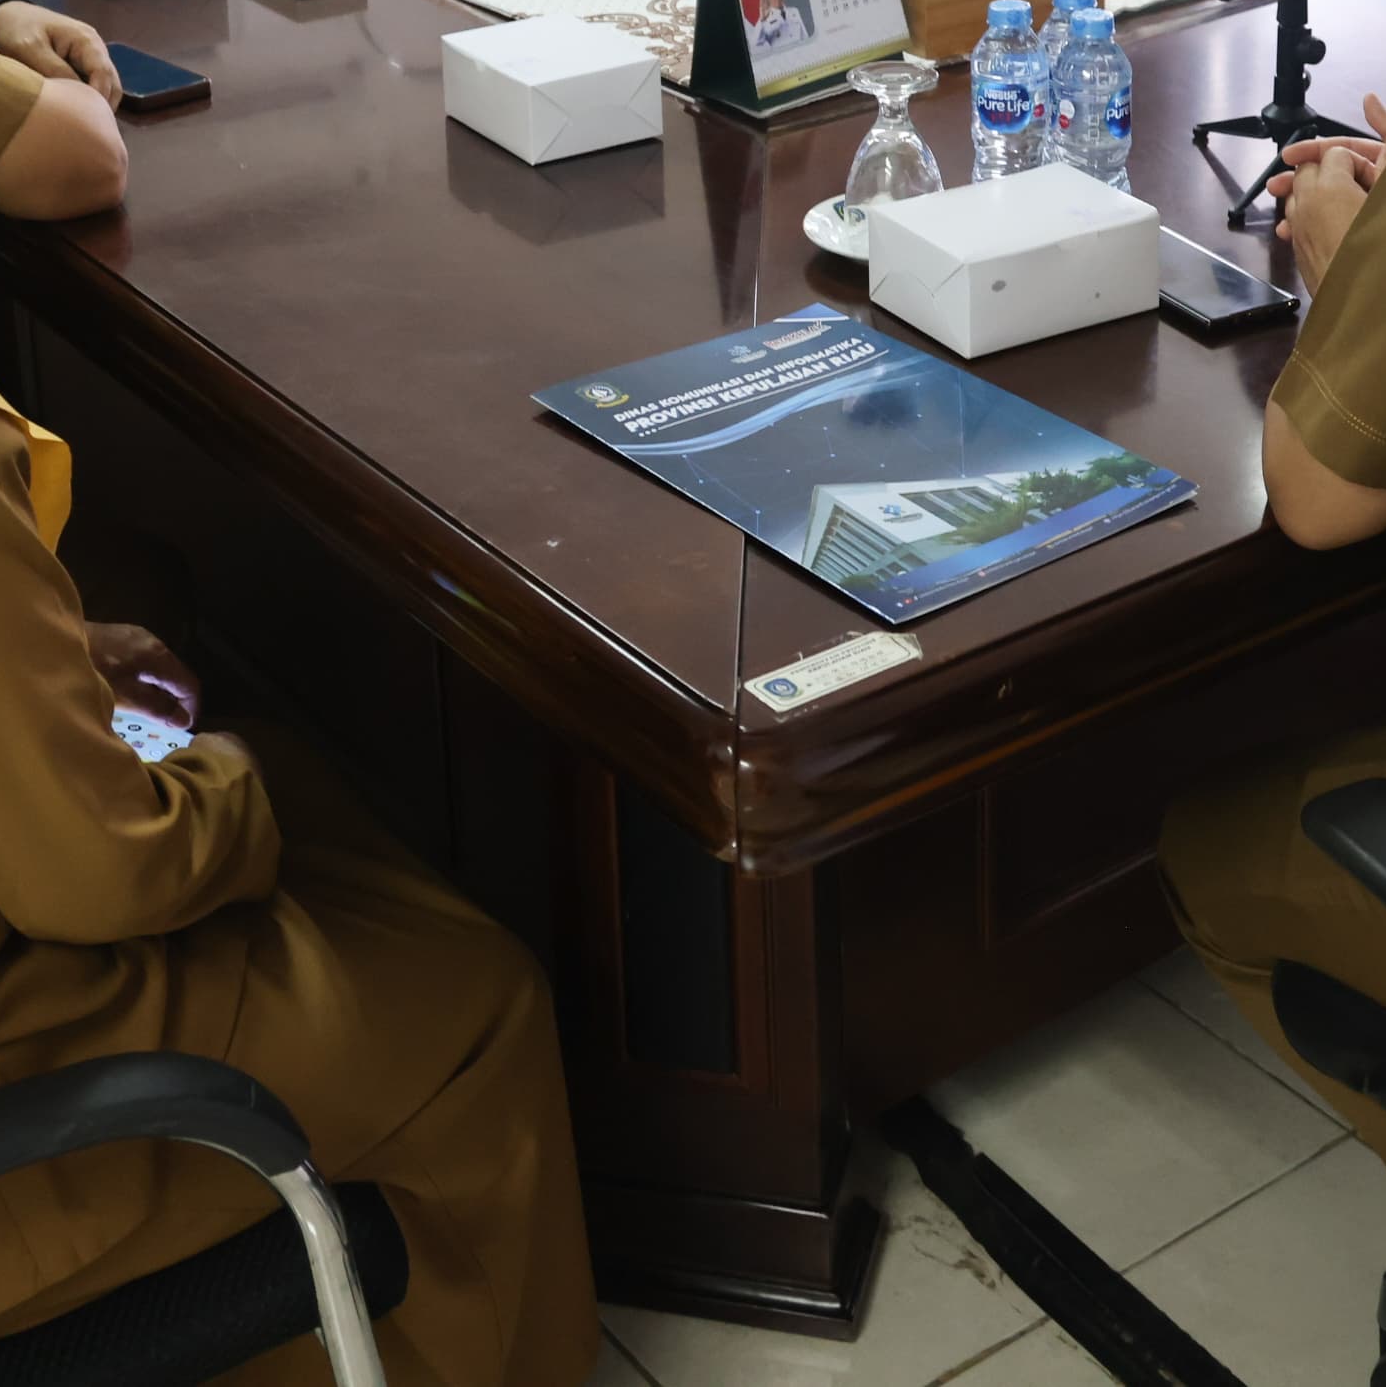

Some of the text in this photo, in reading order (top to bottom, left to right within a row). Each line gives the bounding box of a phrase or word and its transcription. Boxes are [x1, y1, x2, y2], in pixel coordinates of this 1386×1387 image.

[977, 95, 1031, 117] Pure Life
[613, 402, 659, 423] DINAS
[658, 376, 744, 408] KOMUNIKASI
[743, 367, 775, 382] DAN
[774, 337, 863, 372] INFORMATIKA
[624, 342, 876, 433] PROVINSI KEPULAUAN RIAU
